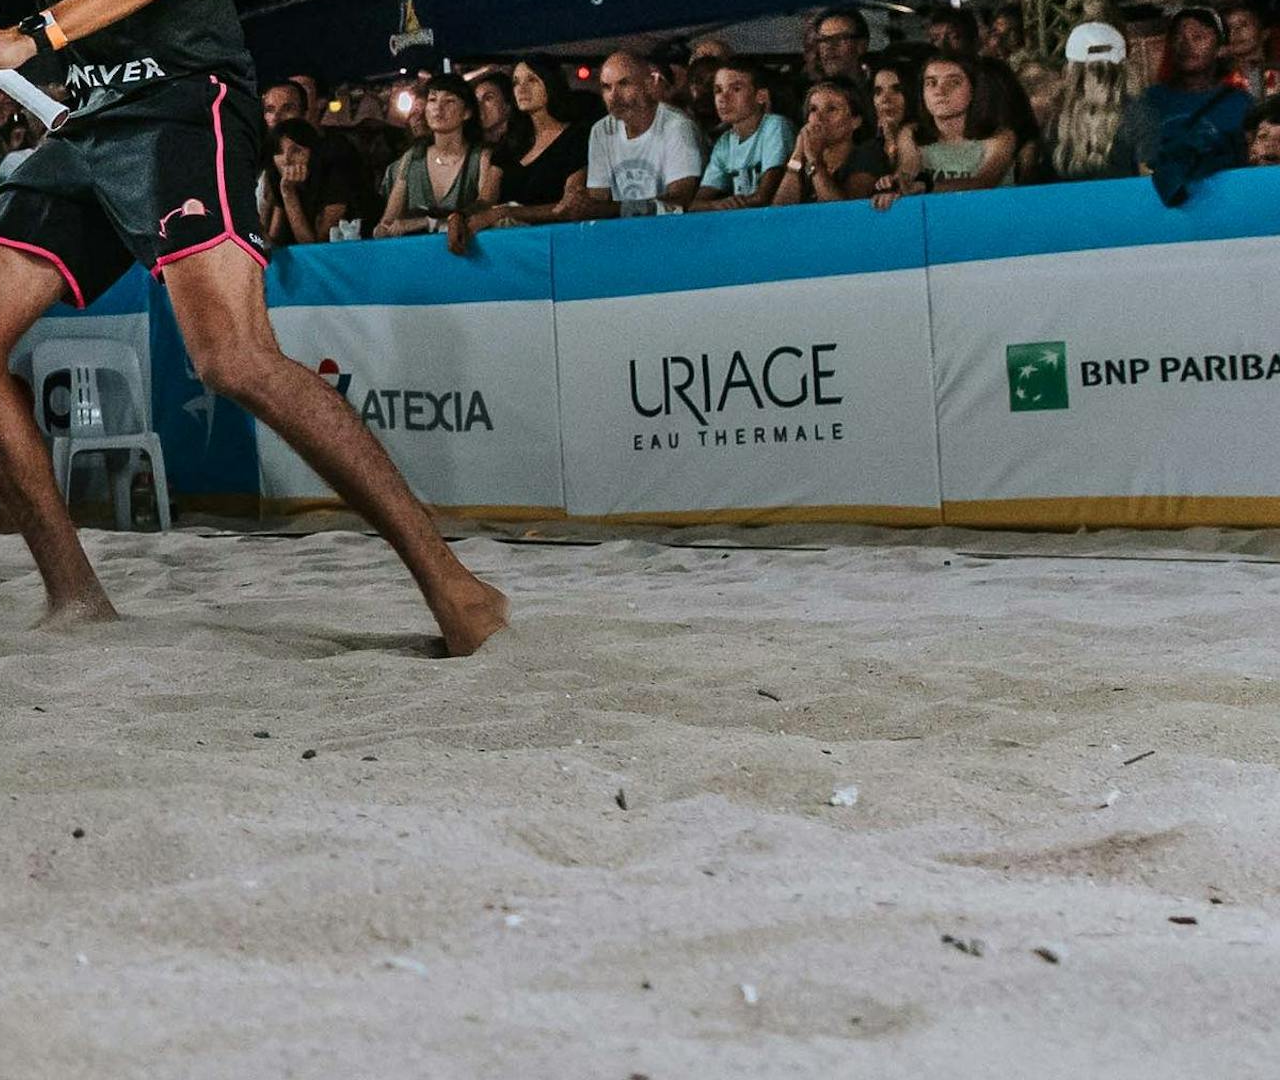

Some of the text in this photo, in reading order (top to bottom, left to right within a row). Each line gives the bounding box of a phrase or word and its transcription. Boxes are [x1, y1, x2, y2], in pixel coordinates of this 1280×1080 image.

[629, 343, 844, 426] URIAGE
[1081, 358, 1150, 387] BNP
[633, 422, 845, 450] EAU THERMALE
